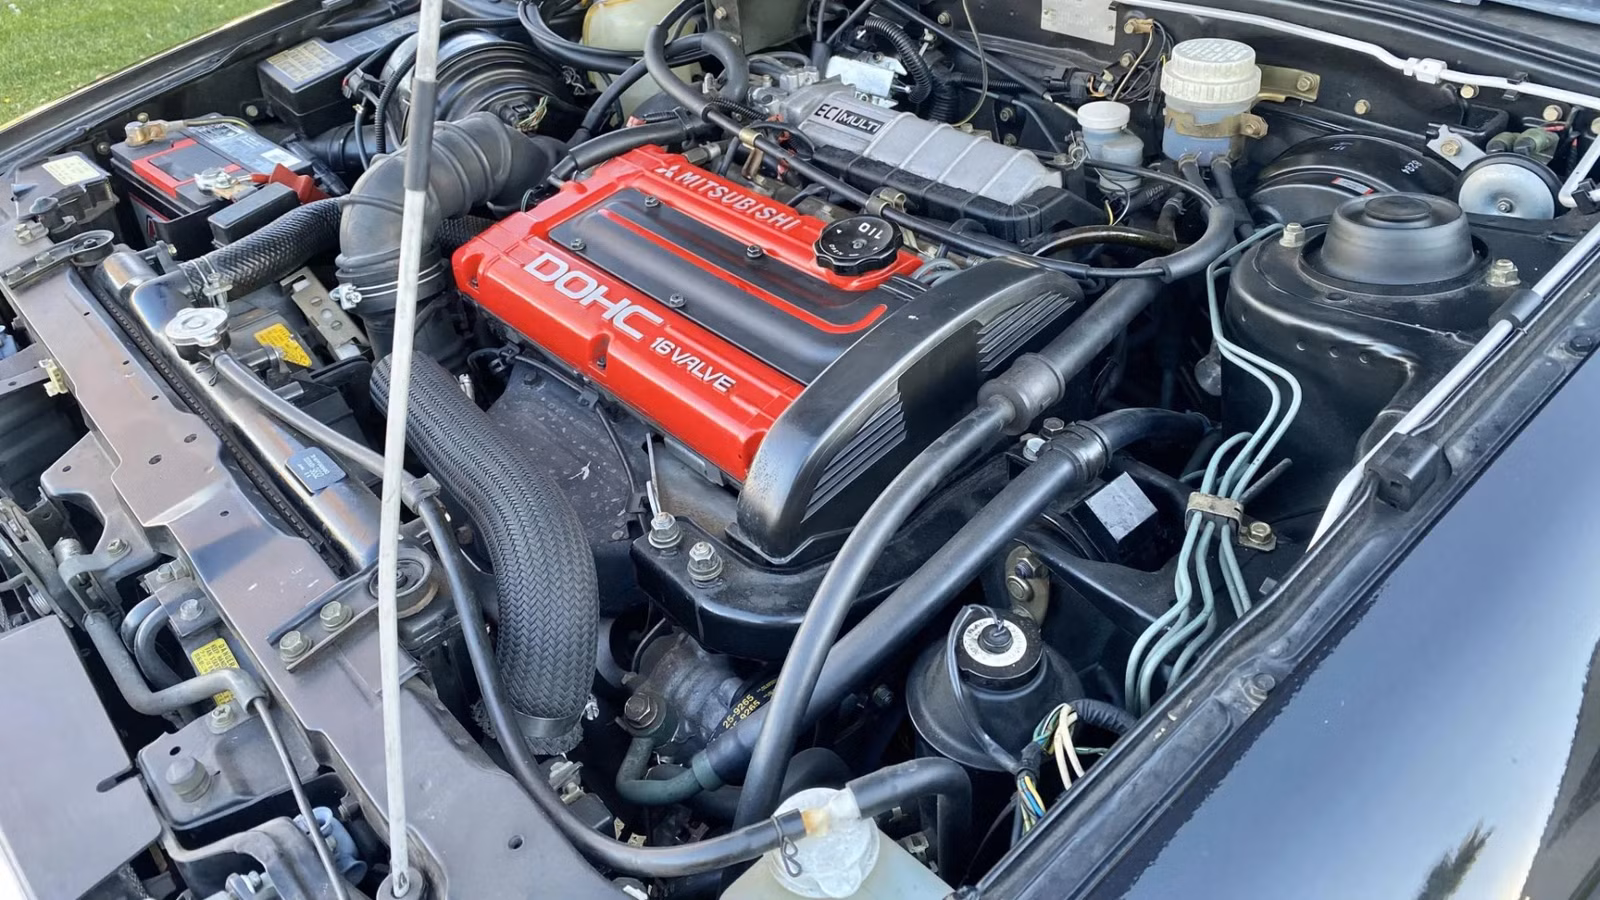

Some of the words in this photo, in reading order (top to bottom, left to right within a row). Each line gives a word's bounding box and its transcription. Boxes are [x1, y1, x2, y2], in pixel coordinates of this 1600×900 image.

[838, 112, 882, 133] MULTI
[674, 171, 801, 231] MITSUBISHI
[858, 222, 884, 240] OIL
[523, 252, 664, 339] DOHC
[722, 694, 754, 729] 25-9265
